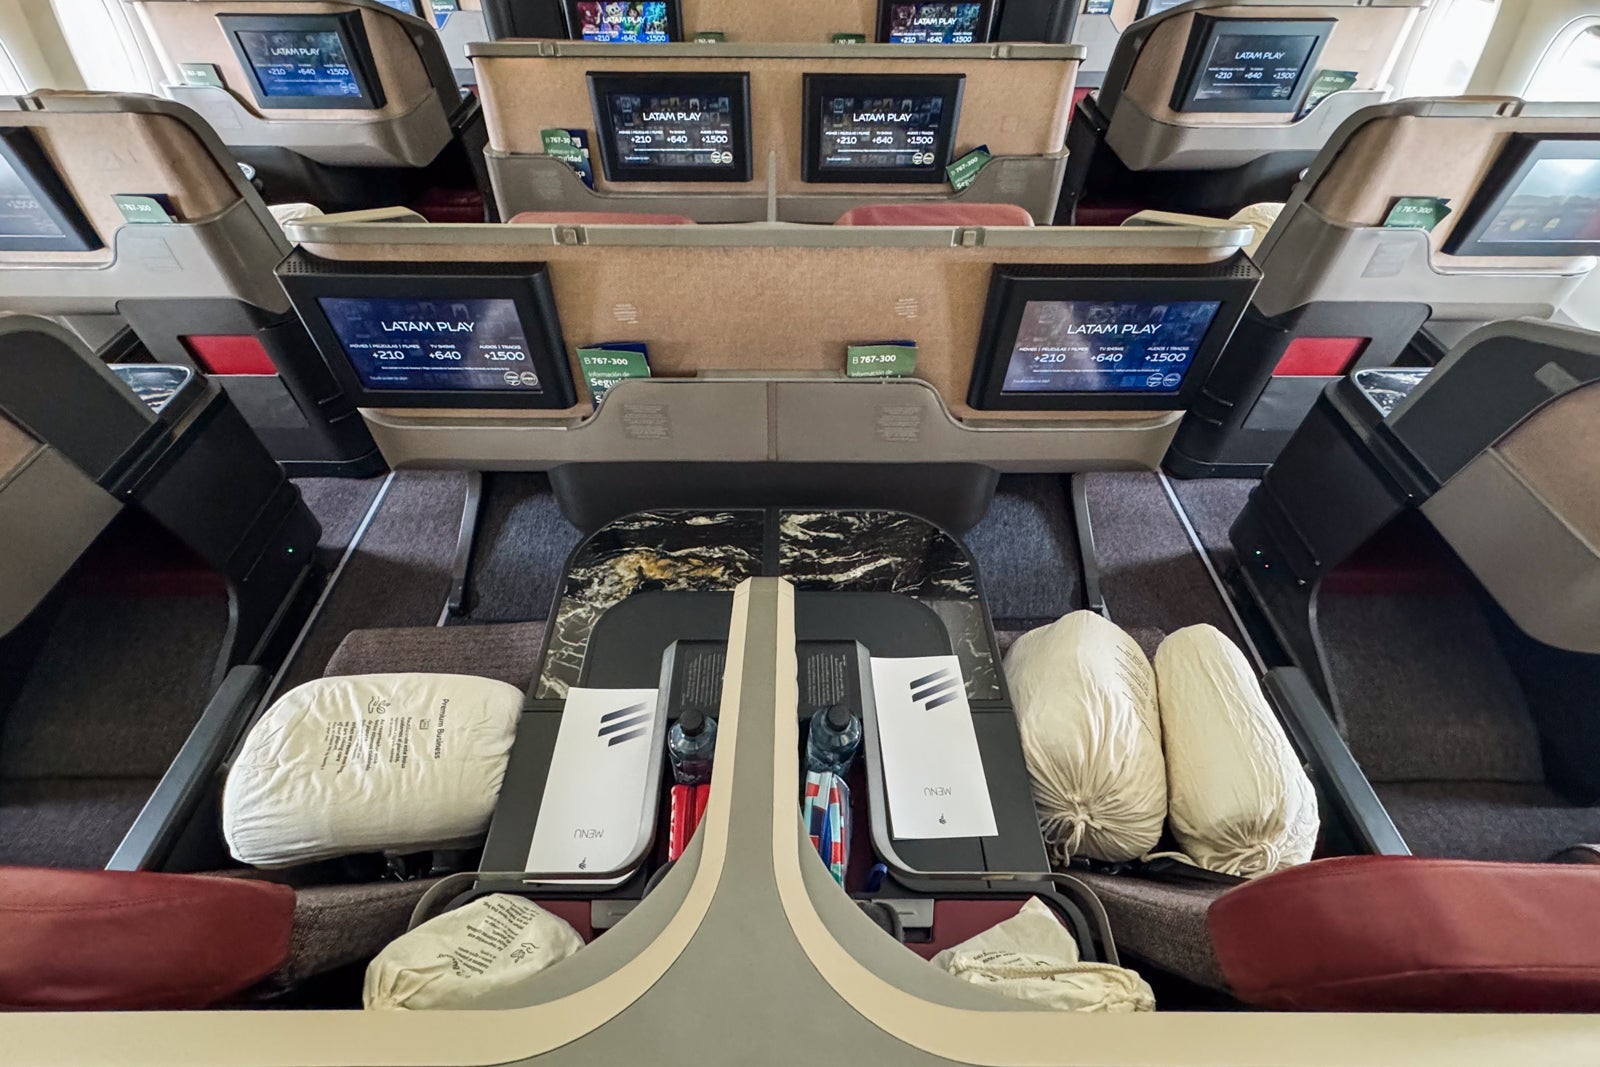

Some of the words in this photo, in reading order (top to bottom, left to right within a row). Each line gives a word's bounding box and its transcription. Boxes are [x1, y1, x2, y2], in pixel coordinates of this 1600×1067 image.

[628, 16, 645, 24] PLAY
[642, 112, 676, 121] LATAM
[677, 112, 701, 121] PLAY
[853, 113, 885, 122] LATAM
[888, 113, 912, 122] PLAY
[381, 321, 435, 332] LATAM
[438, 321, 475, 332] PLAY
[1067, 324, 1118, 334] LATAM
[1121, 324, 1162, 334] PLAY
[372, 351, 405, 360] +210
[429, 351, 461, 360] +640
[484, 351, 525, 360] +1500
[860, 355, 896, 363] 767-300
[1034, 354, 1066, 362] +210
[1090, 353, 1123, 362] +640
[1145, 353, 1186, 362] +1500
[438, 698, 449, 728] Premium
[434, 728, 444, 759] Business
[924, 786, 951, 796] MENU
[574, 828, 604, 838] MENU
